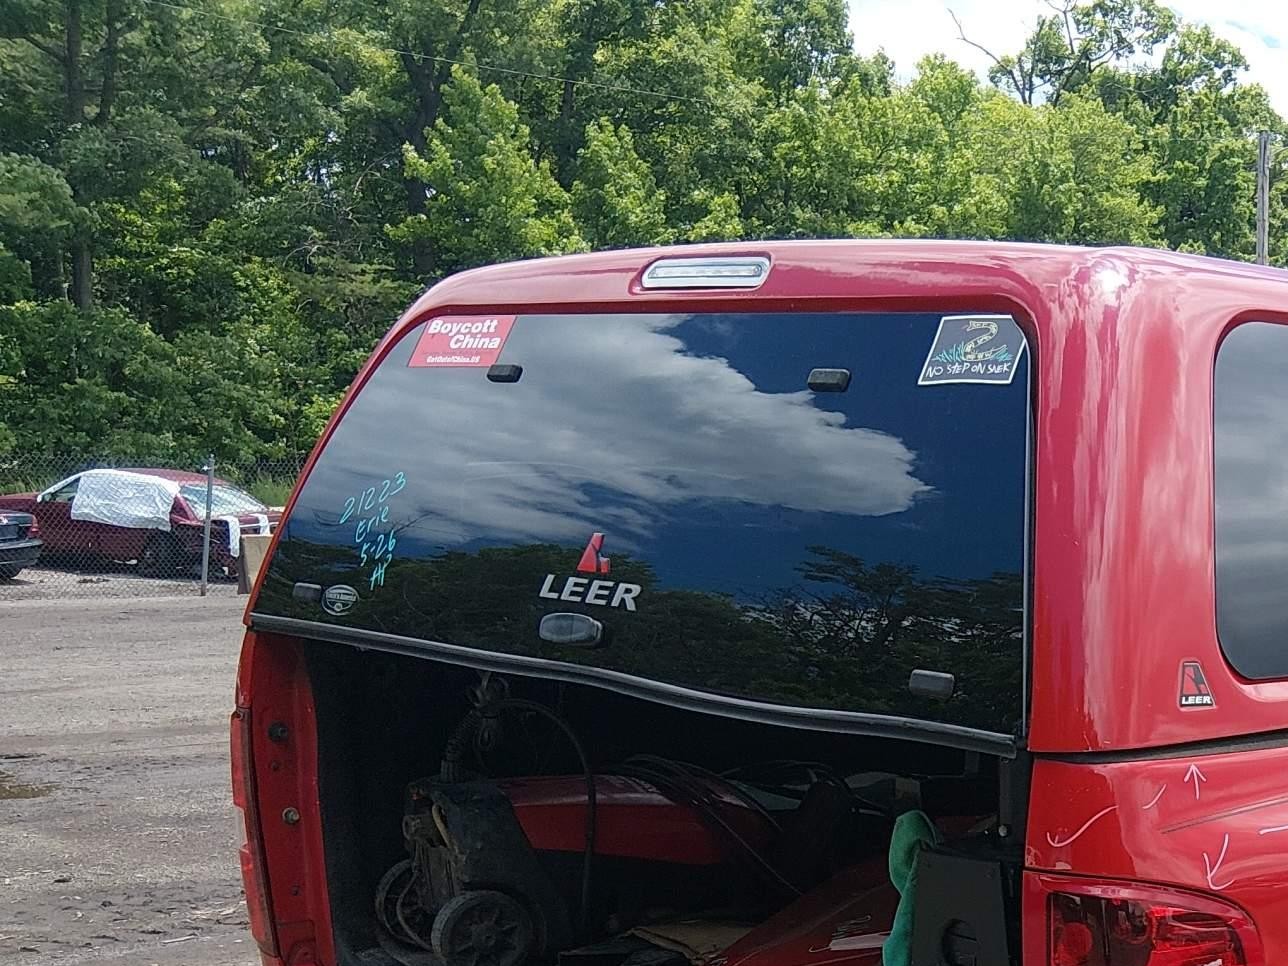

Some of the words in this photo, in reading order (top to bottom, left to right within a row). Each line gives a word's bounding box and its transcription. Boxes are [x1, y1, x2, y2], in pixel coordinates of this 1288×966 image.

[428, 319, 498, 336] Boycott
[449, 335, 501, 349] China
[926, 366, 944, 378] NO
[946, 362, 970, 374] STEP
[971, 362, 986, 374] ON
[340, 472, 406, 524] 21223
[360, 530, 396, 567] 5-26
[539, 574, 642, 612] LEER
[1181, 695, 1212, 704] LEER
